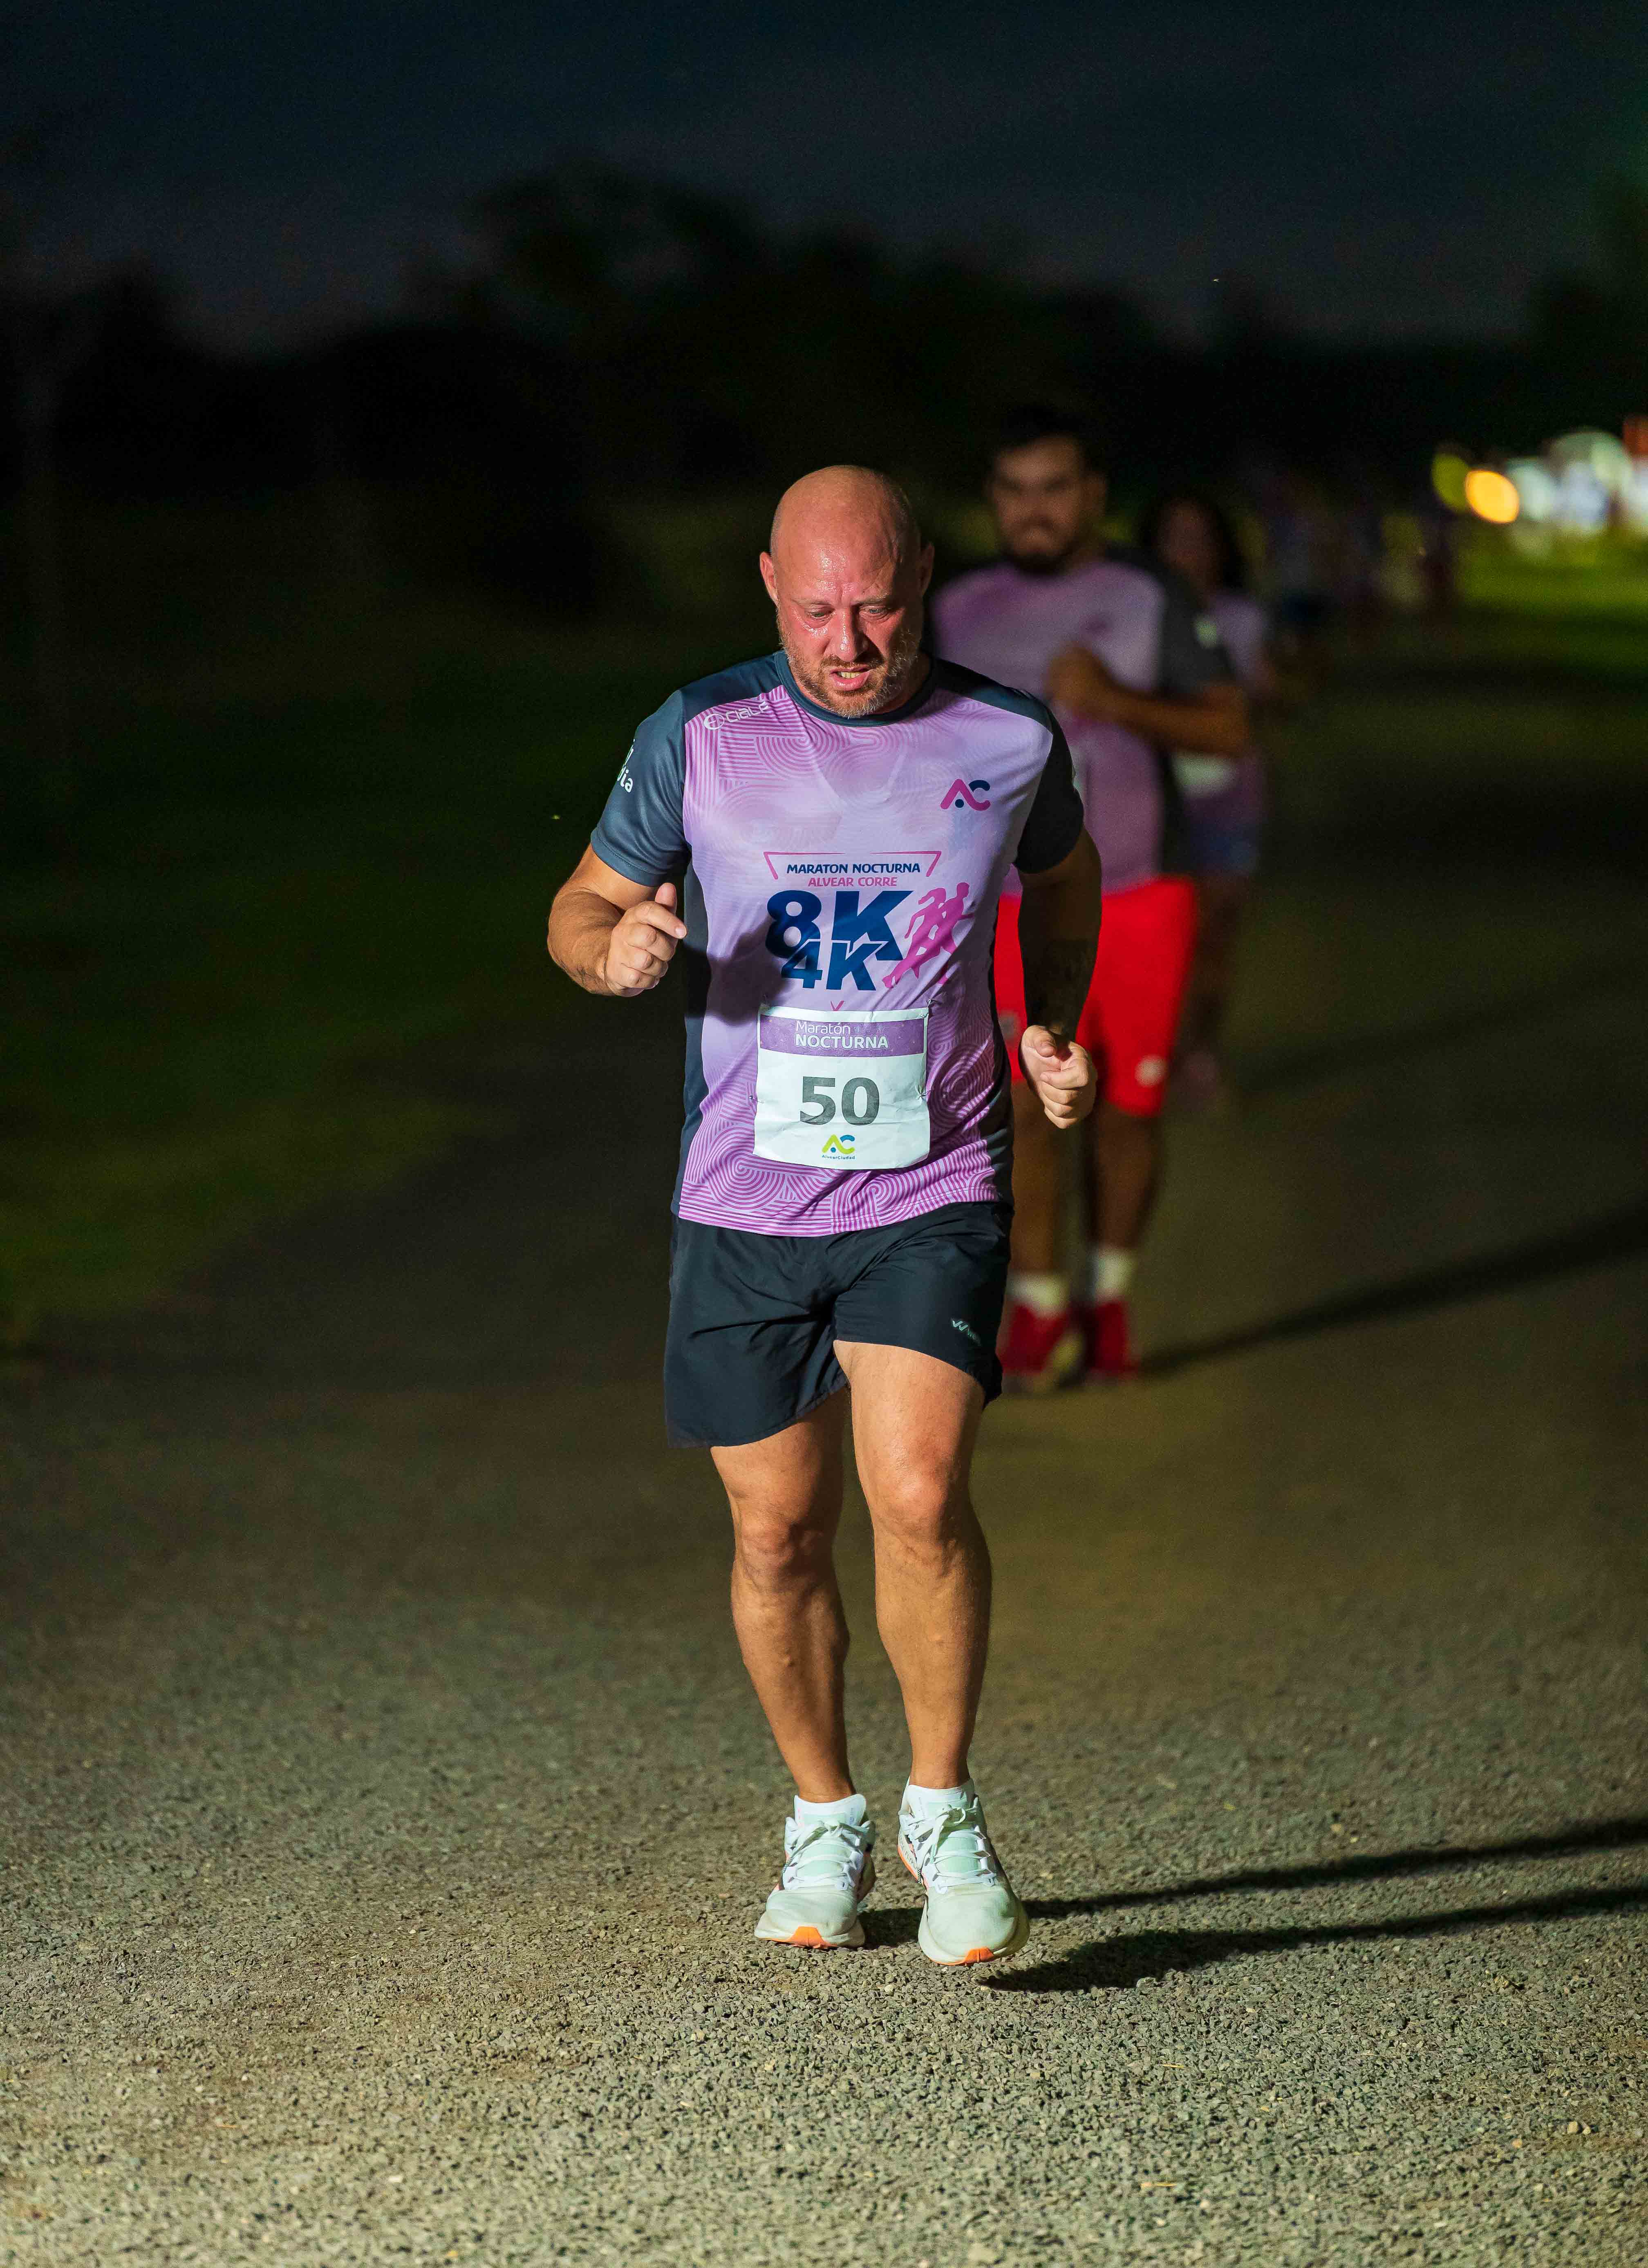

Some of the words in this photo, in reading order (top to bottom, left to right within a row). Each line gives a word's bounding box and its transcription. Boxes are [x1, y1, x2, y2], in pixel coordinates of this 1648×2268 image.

[786, 863, 848, 874] MARATON
[852, 863, 920, 873] NOCTURNA
[807, 877, 854, 887] ALVEAR
[858, 877, 898, 887] CORRE
[765, 890, 914, 961] 8K
[781, 941, 884, 991] 4K
[796, 1020, 851, 1035] Maratón
[795, 1033, 889, 1049] NOCTURNA
[799, 1076, 880, 1126] 50
